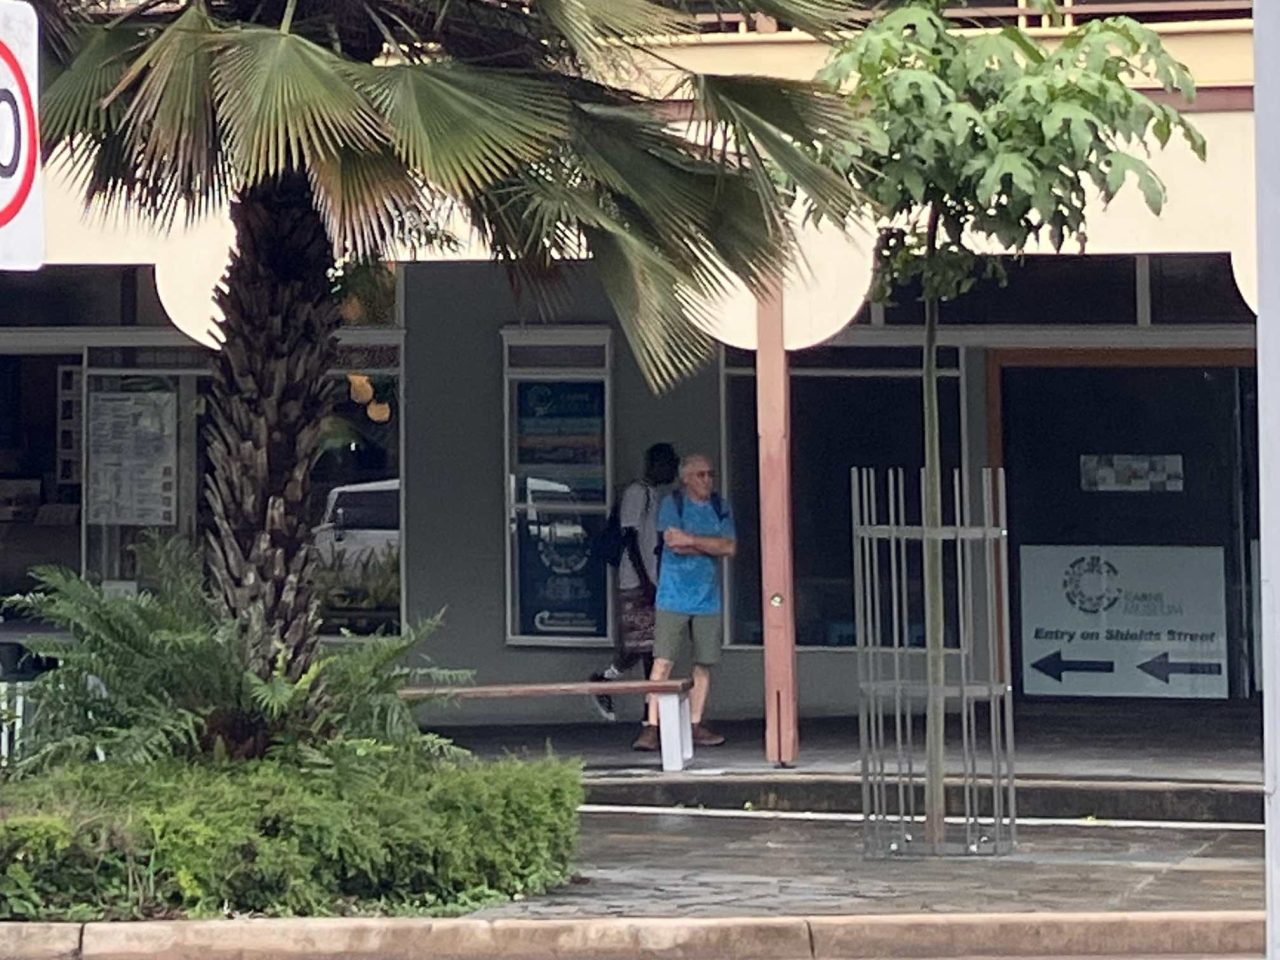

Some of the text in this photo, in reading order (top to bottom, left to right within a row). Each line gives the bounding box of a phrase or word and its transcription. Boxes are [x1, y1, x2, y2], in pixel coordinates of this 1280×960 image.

[1034, 627, 1076, 643] Entry
[1080, 631, 1100, 641] on
[1167, 629, 1216, 642] Street
